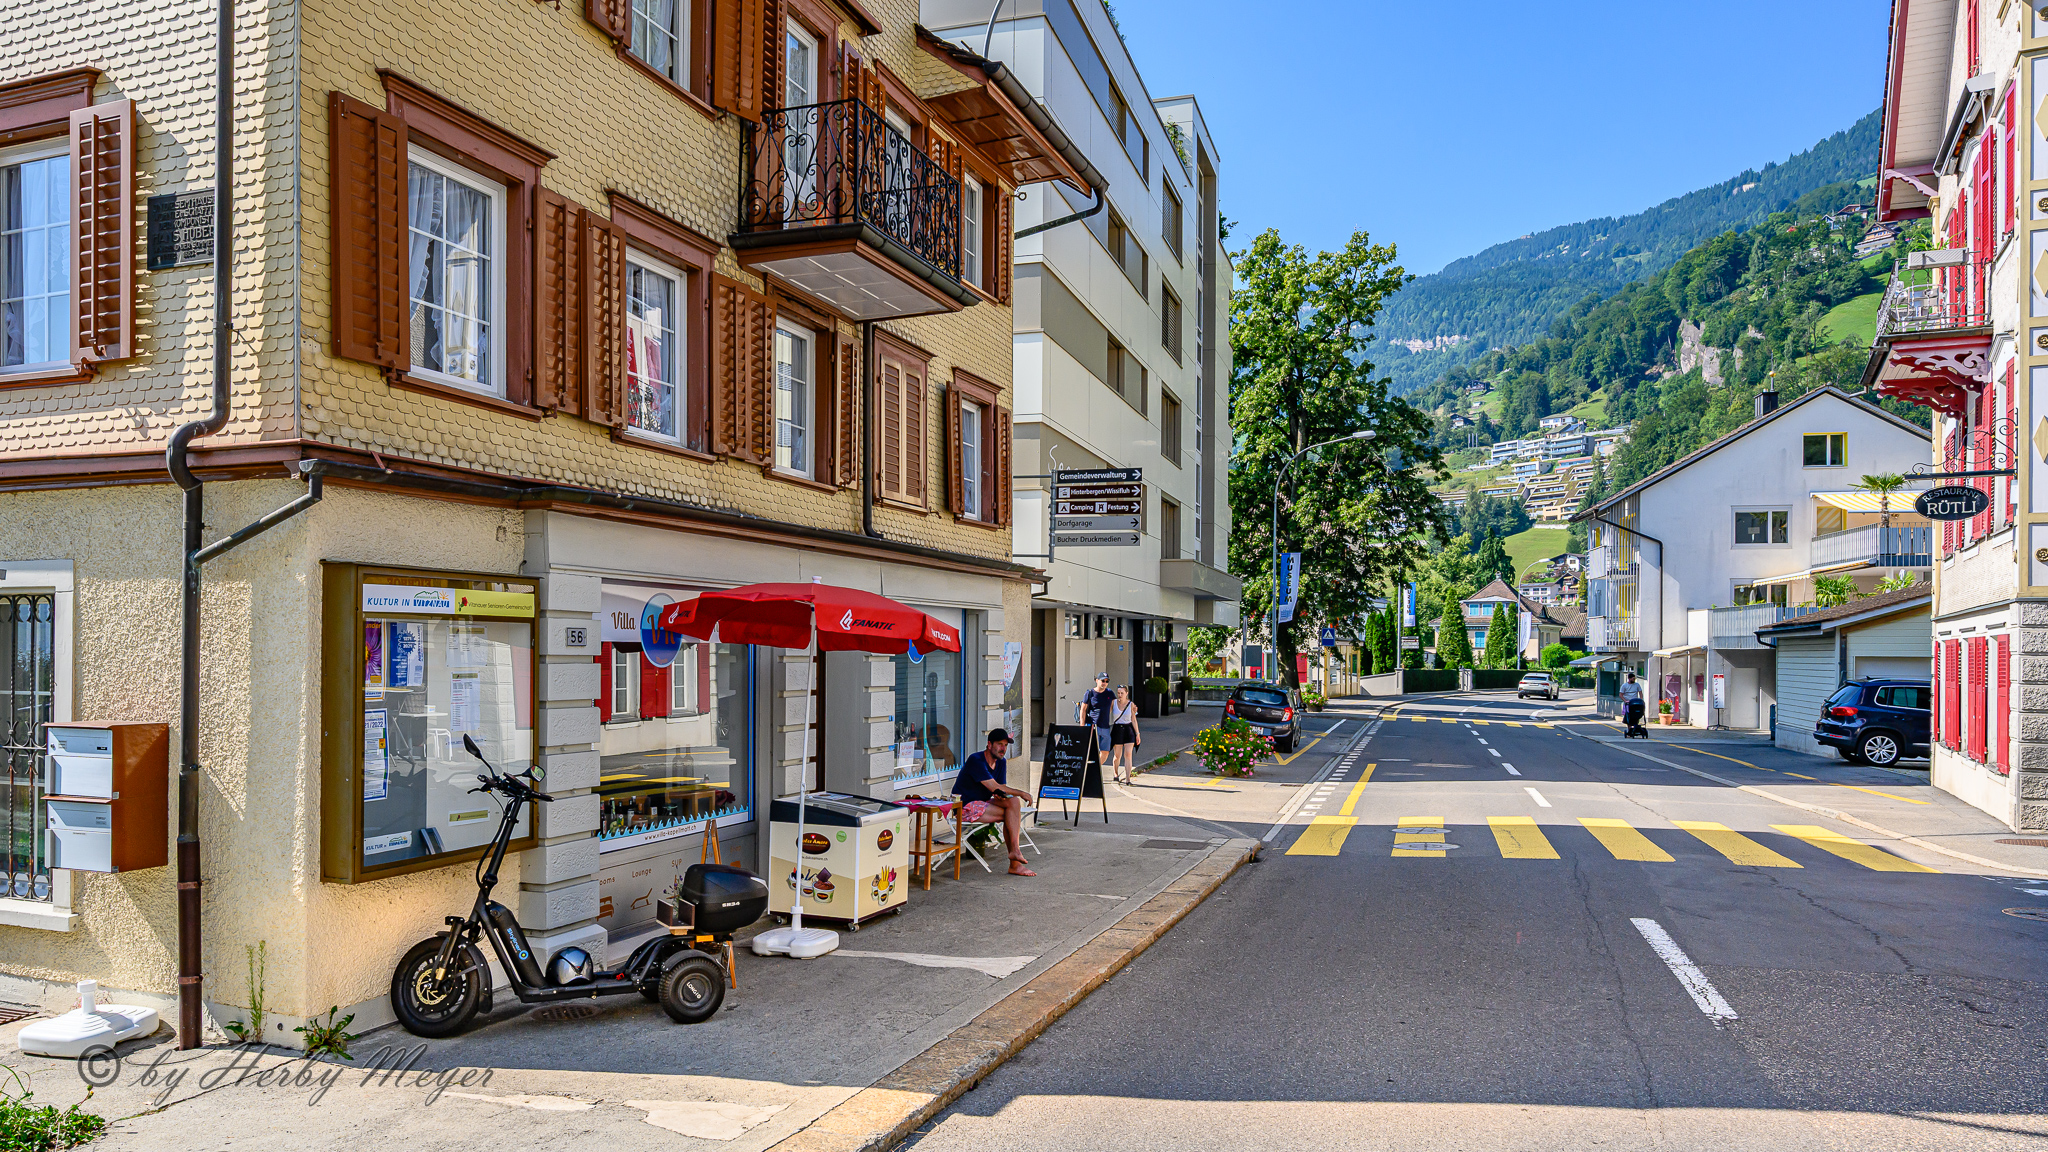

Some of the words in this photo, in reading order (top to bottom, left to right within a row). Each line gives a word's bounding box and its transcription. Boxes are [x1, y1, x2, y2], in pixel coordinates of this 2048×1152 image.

[1060, 471, 1126, 480] Gemeindeverwaltung
[1922, 488, 1981, 502] RESTAURANT
[1927, 500, 1977, 515] RÜTLI
[1284, 557, 1294, 602] MUSEUM
[367, 598, 398, 606] KULTUR
[611, 611, 636, 630] Villa
[851, 619, 895, 630] FANATIC
[571, 630, 584, 643] 56
[671, 859, 682, 867] SUP
[632, 868, 652, 878] Lounge
[600, 877, 615, 886] ooms
